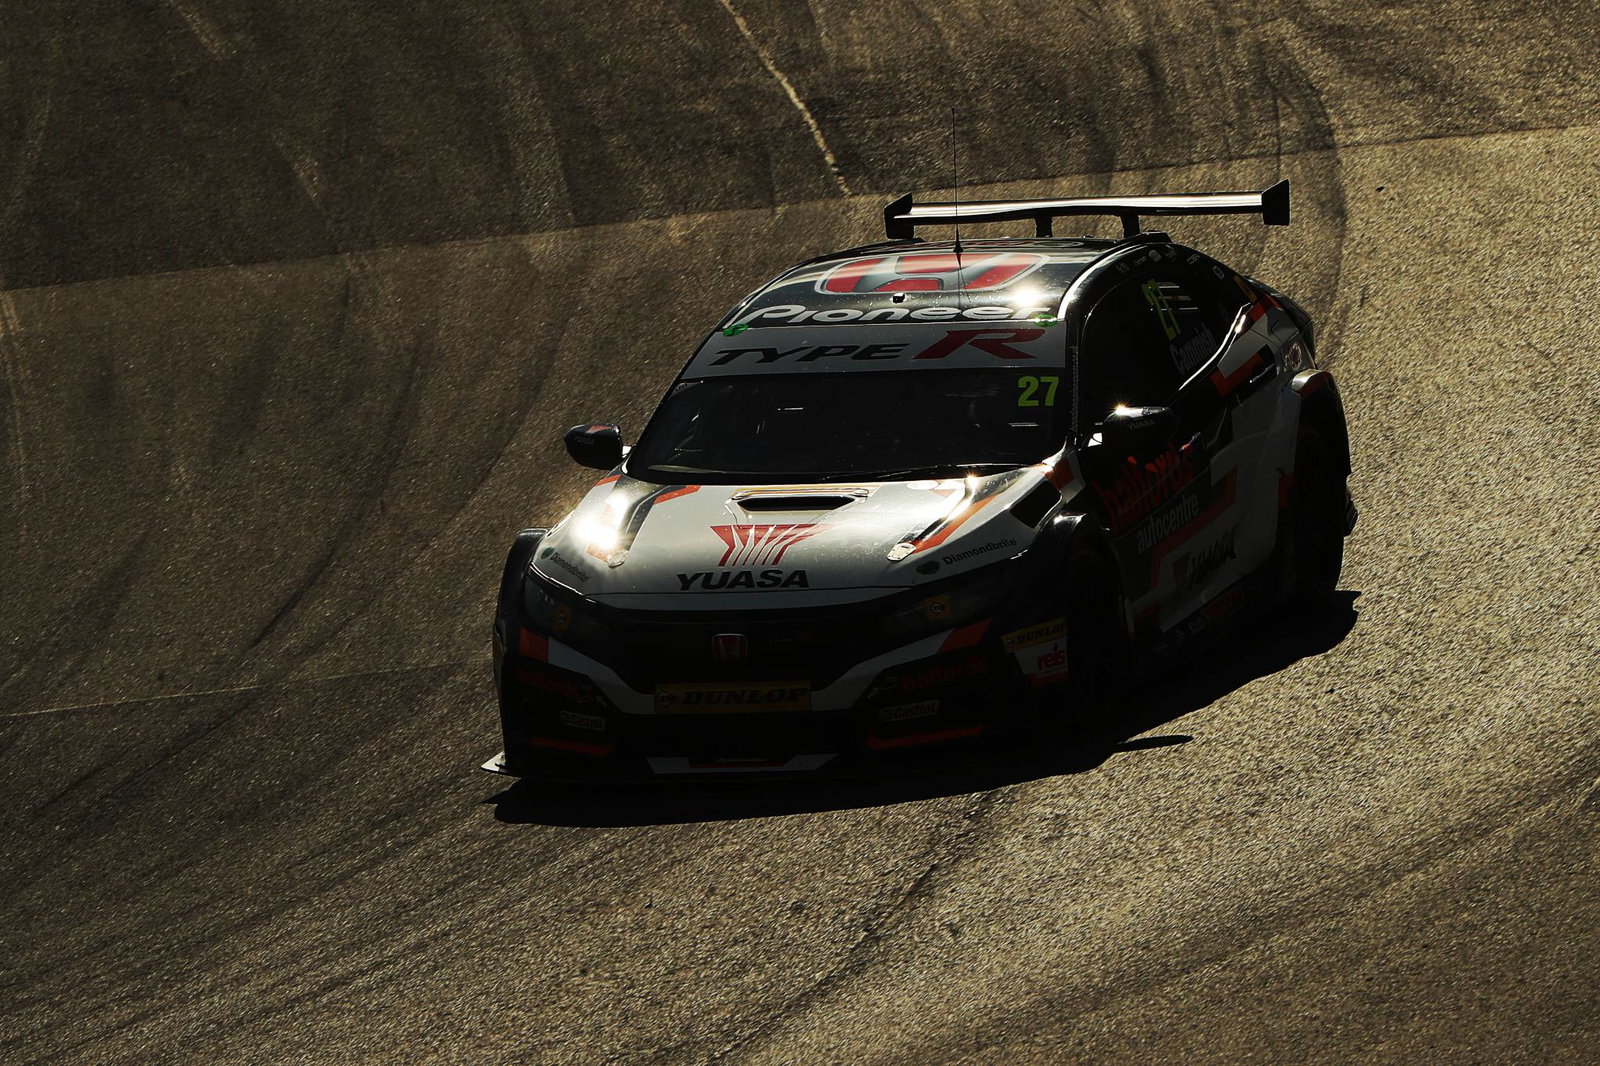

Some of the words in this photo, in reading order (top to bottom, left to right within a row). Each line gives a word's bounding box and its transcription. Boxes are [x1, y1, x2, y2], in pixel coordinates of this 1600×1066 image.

[739, 304, 1053, 324] Pioneer
[709, 343, 909, 367] TYPE
[913, 328, 1046, 361] R
[1016, 376, 1061, 408] 27
[1135, 493, 1201, 556] autocentre
[942, 538, 1017, 566] Diamondbrite
[677, 569, 810, 591] YUASA
[683, 687, 810, 705] DUNLOP
